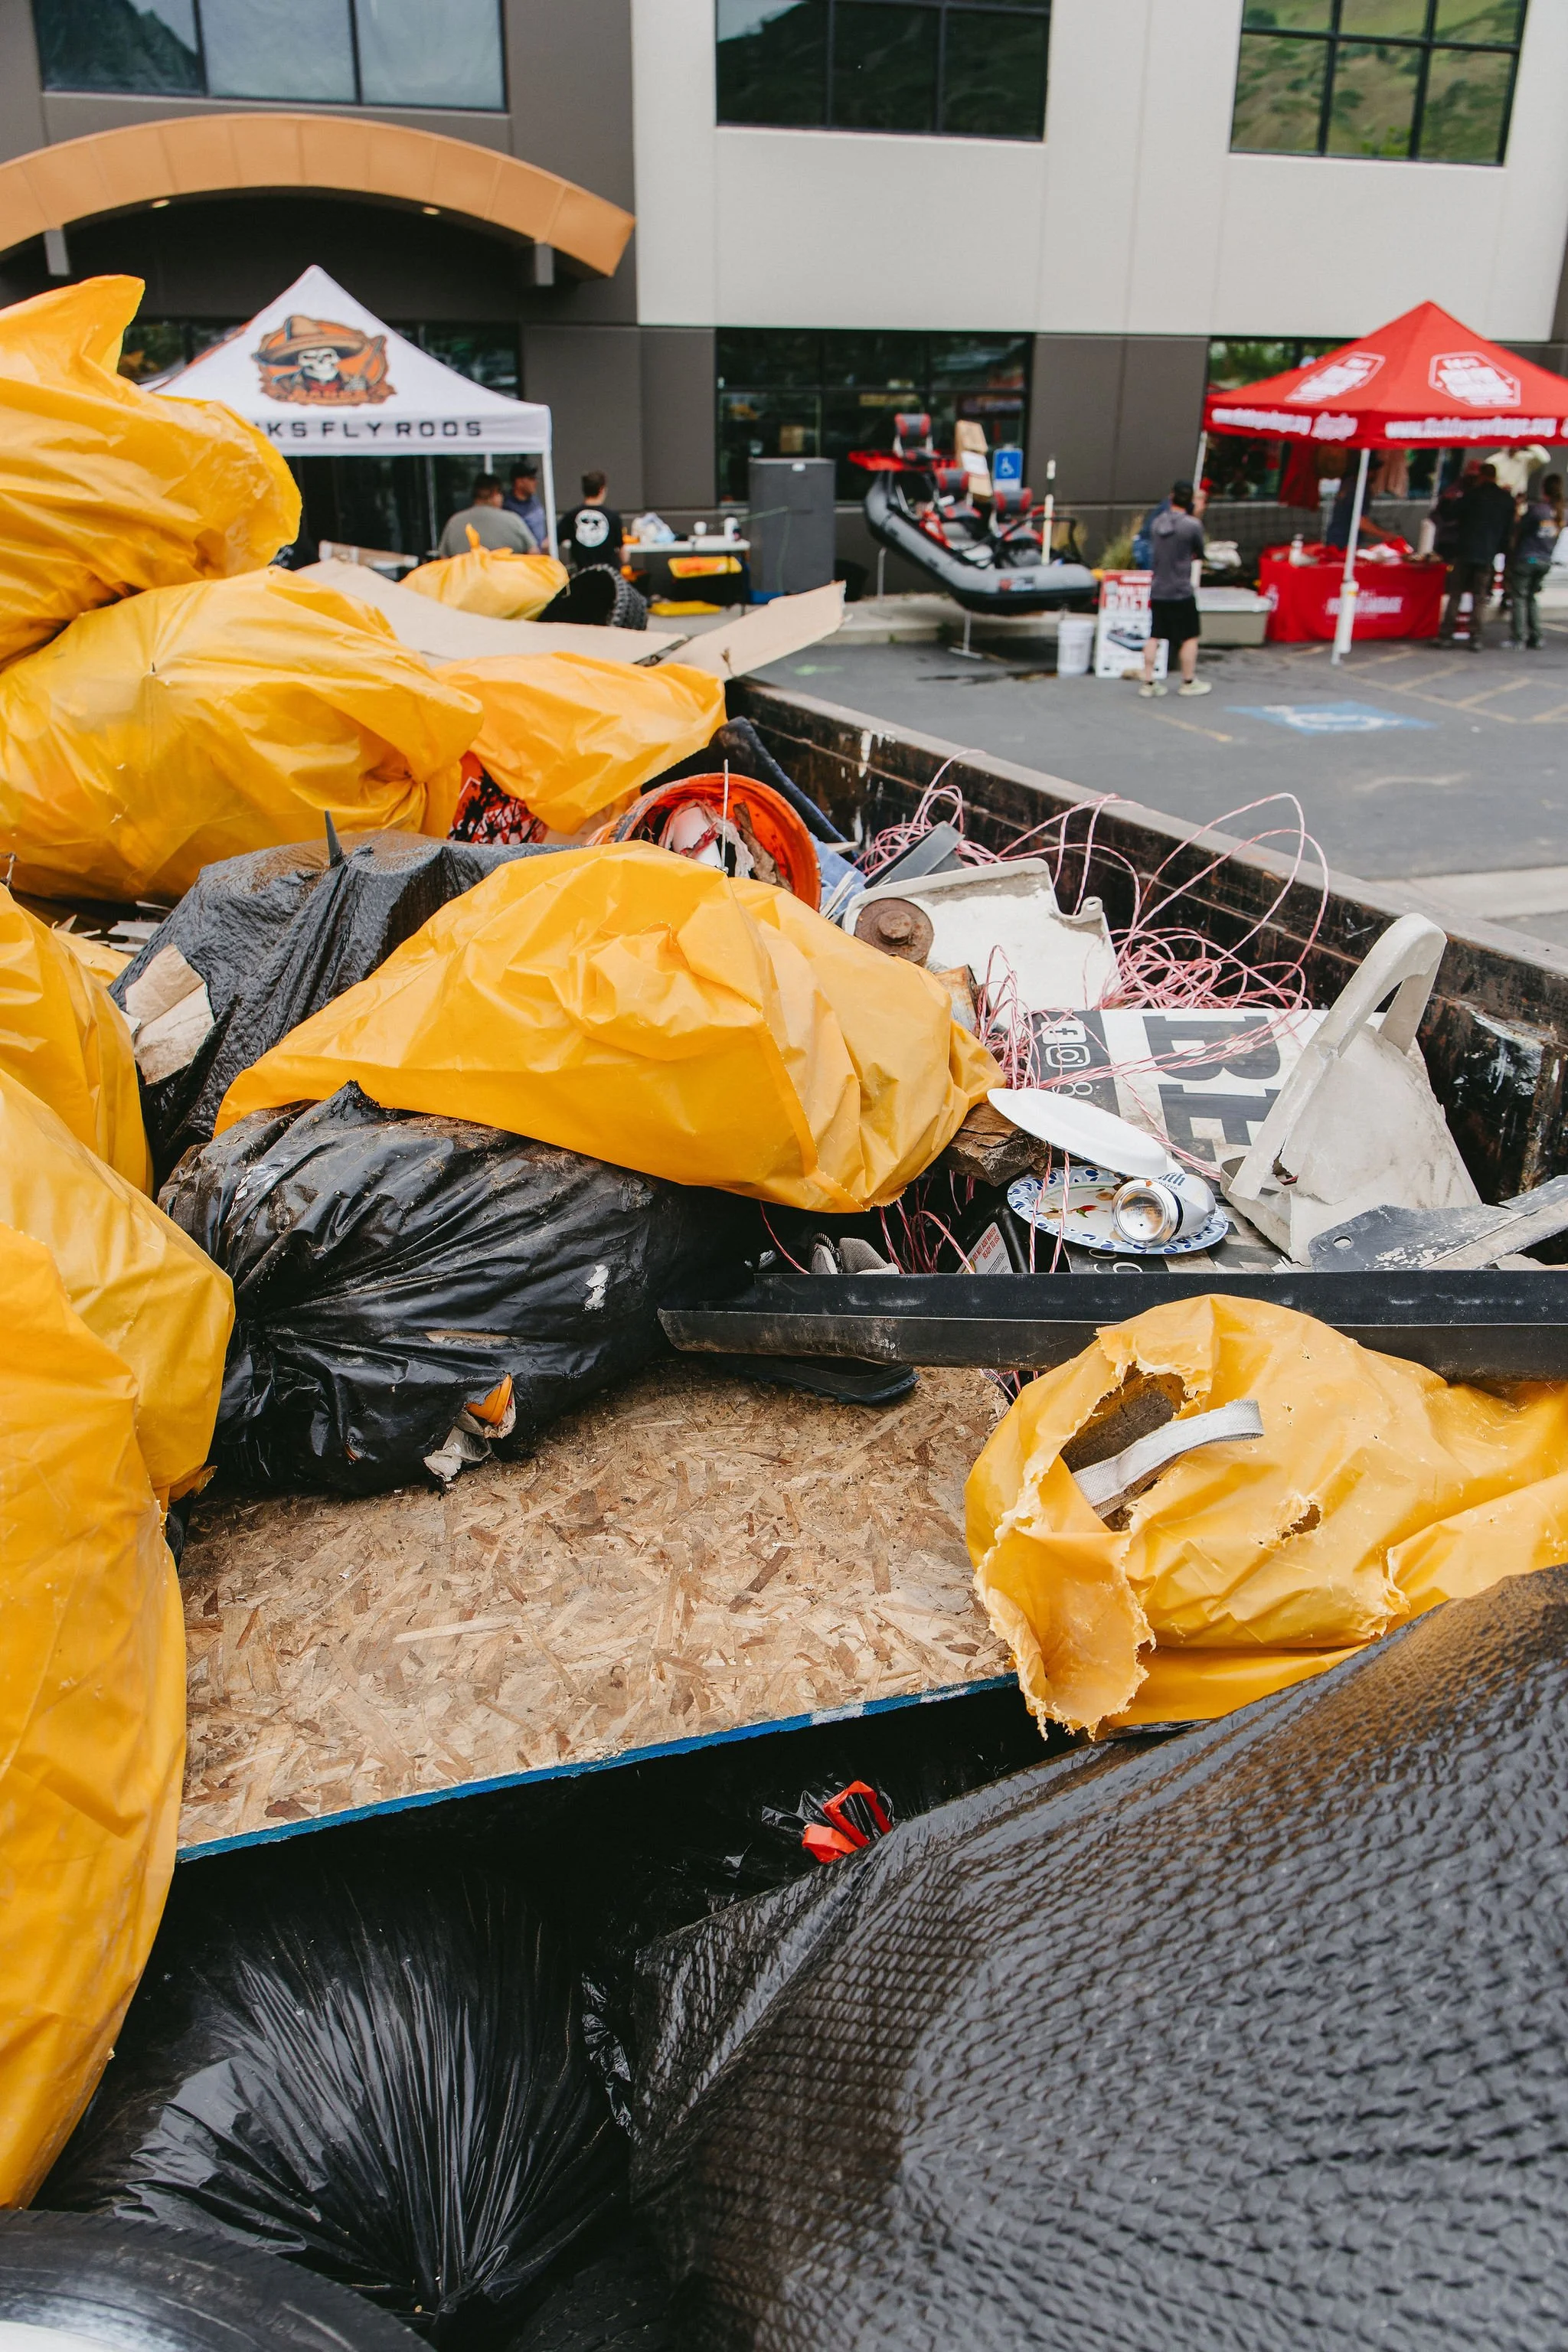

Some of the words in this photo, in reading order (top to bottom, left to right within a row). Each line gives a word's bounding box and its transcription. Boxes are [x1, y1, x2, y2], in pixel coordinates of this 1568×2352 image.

[255, 422, 307, 437] KS
[322, 422, 381, 437] FLY
[986, 1227, 997, 1240] WATER
